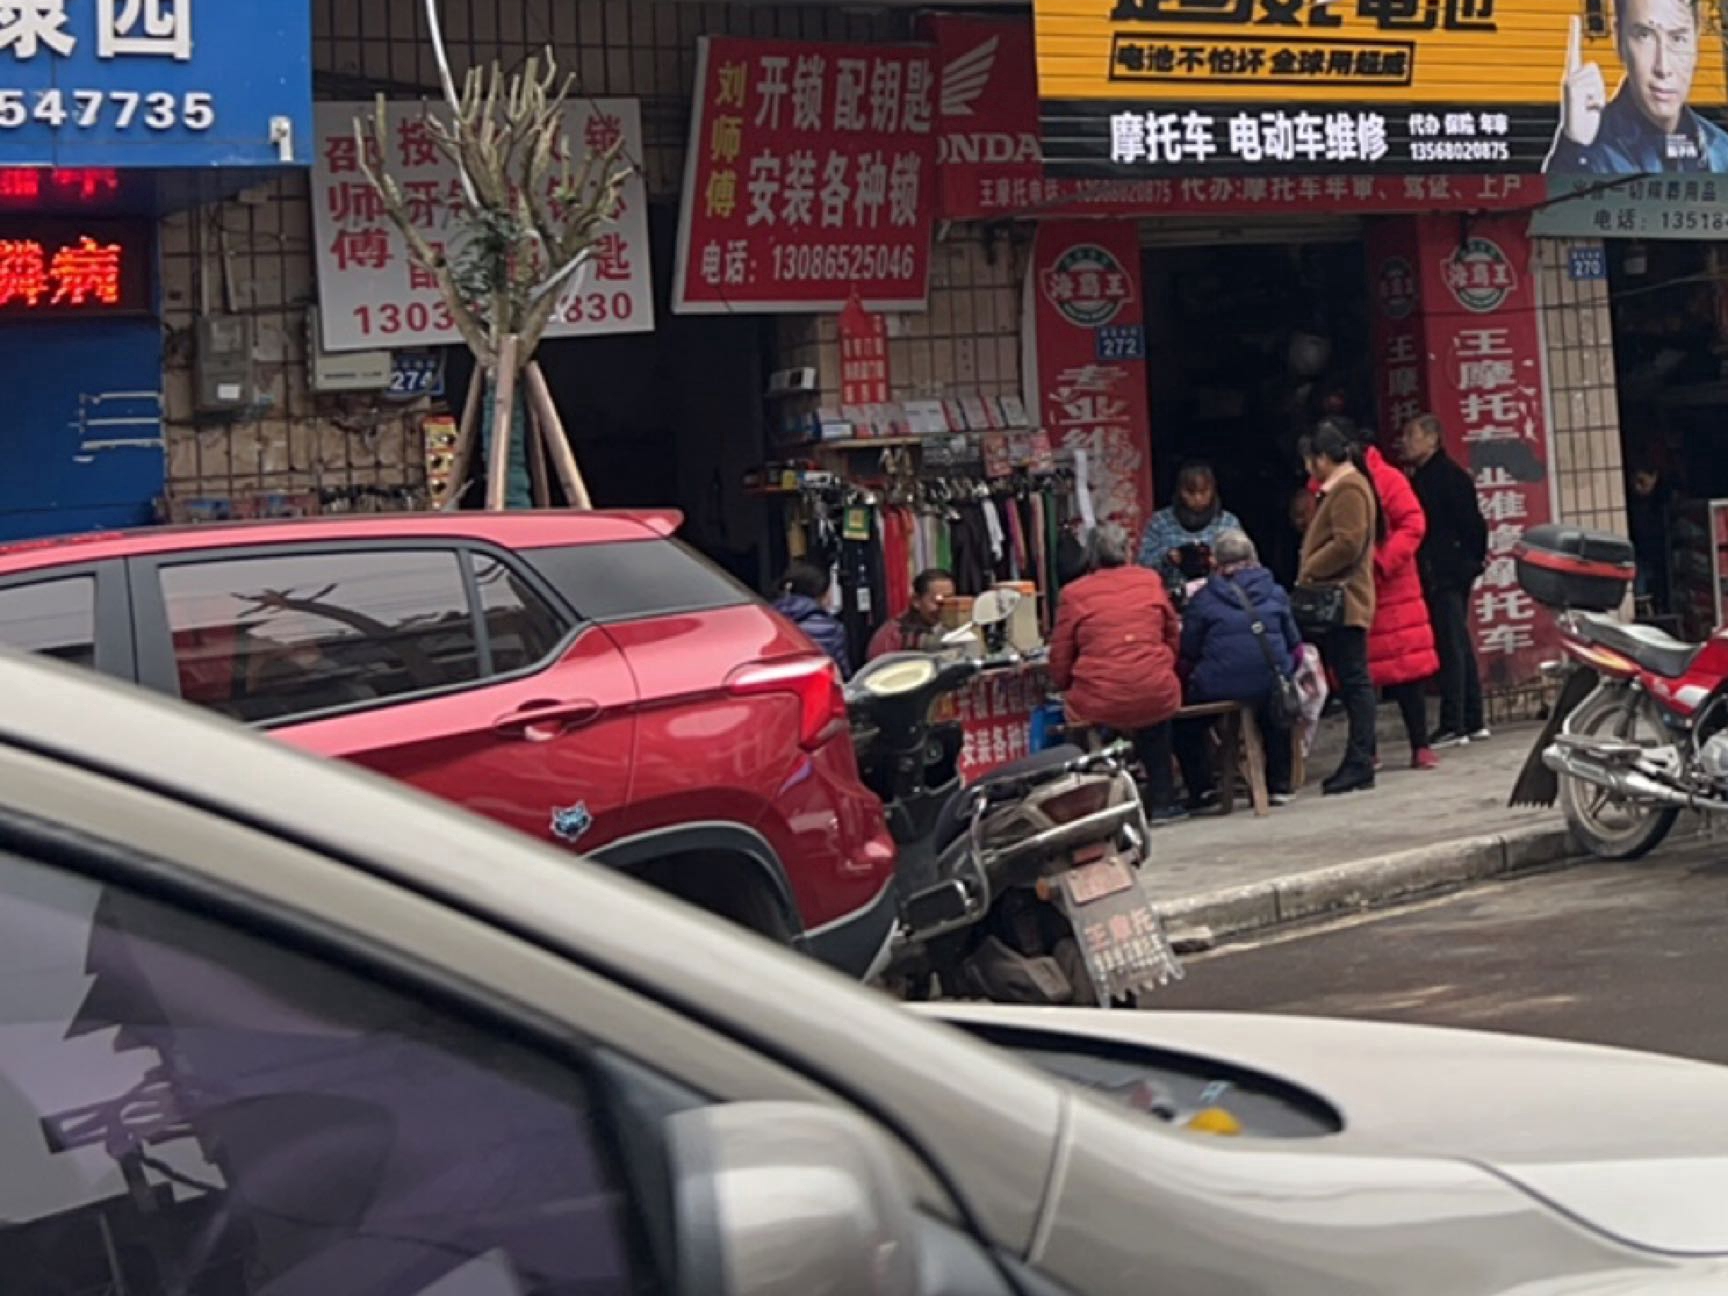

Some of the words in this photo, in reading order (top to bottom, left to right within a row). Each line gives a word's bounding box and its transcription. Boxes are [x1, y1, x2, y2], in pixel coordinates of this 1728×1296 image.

[1116, 42, 1266, 74] 电池不怕坏
[0, 88, 215, 129] 547735
[754, 53, 934, 134] 开锁配钥匙
[706, 60, 748, 219] 刘师傅
[937, 133, 1043, 165] NDA
[1109, 109, 1217, 164] 摩托车
[1229, 110, 1389, 163] 电动车维修
[1409, 113, 1440, 136] 代办
[746, 148, 921, 230] 安装各种锁
[771, 243, 915, 282] 13086525046
[352, 292, 634, 336] 1303830
[1102, 337, 1138, 356] 272
